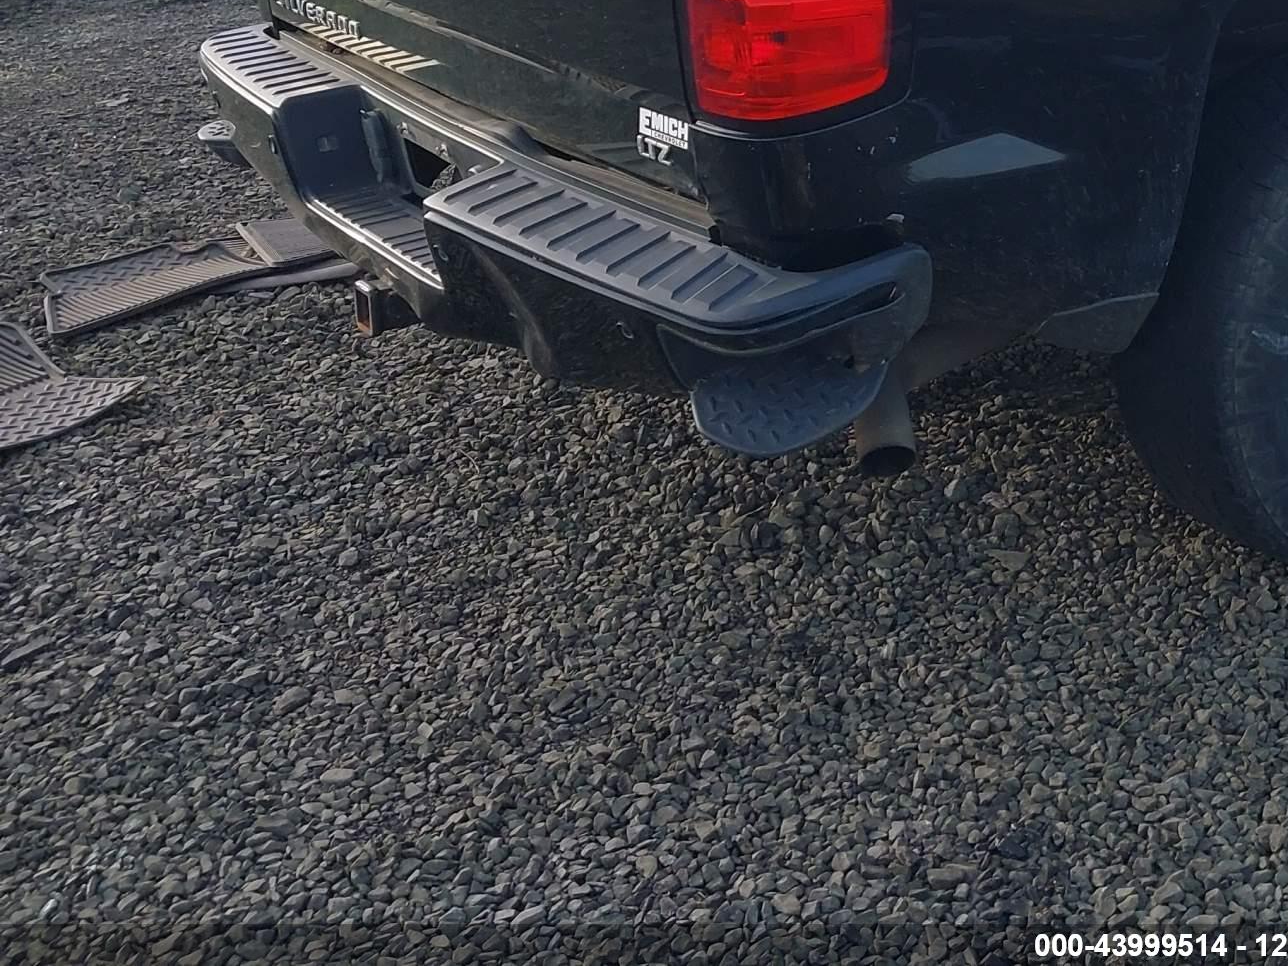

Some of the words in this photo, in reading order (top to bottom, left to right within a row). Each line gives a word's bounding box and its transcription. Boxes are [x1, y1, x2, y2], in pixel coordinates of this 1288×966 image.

[639, 106, 689, 142] EMICH
[654, 131, 687, 148] CHEVROLET
[636, 134, 672, 166] LTZ
